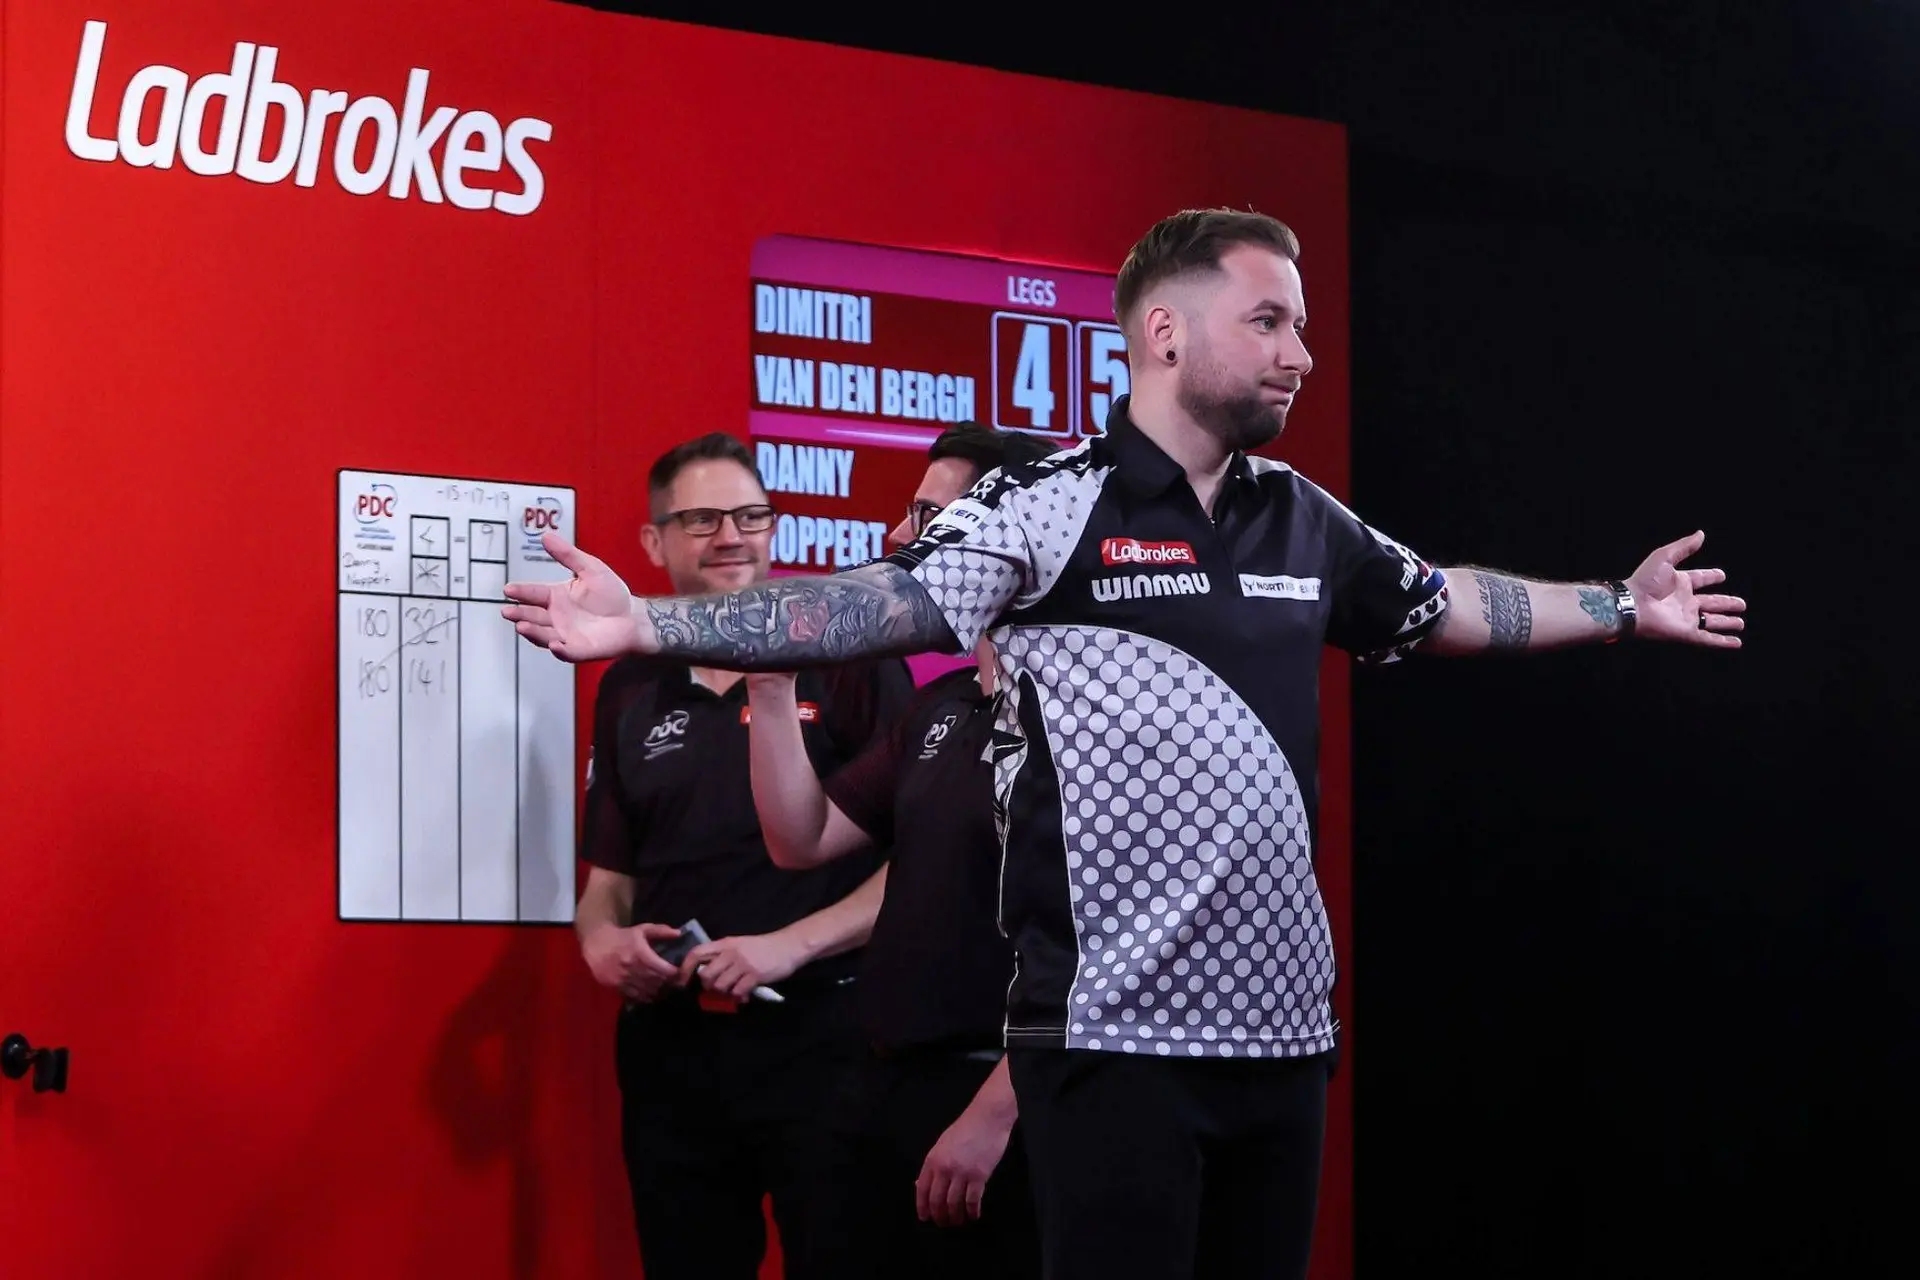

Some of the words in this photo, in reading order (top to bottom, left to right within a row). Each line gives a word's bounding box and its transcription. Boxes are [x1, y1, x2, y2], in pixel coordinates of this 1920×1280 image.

[64, 19, 553, 216] Ladbrokes
[754, 283, 873, 345] DIMITRI
[1007, 275, 1057, 307] LEGS
[754, 354, 815, 409] VAN
[819, 360, 876, 416] DEN
[881, 367, 976, 424] BERGH
[1011, 323, 1056, 428] 4
[1089, 330, 1129, 431] 5
[755, 441, 856, 499] DANNY
[357, 493, 394, 518] PDC
[523, 507, 559, 530] PDC
[769, 513, 888, 569] OPPERT
[1110, 541, 1191, 561] Ladbrokes
[1091, 572, 1212, 602] WINMAU
[357, 606, 391, 638] 180
[407, 658, 446, 696] 141
